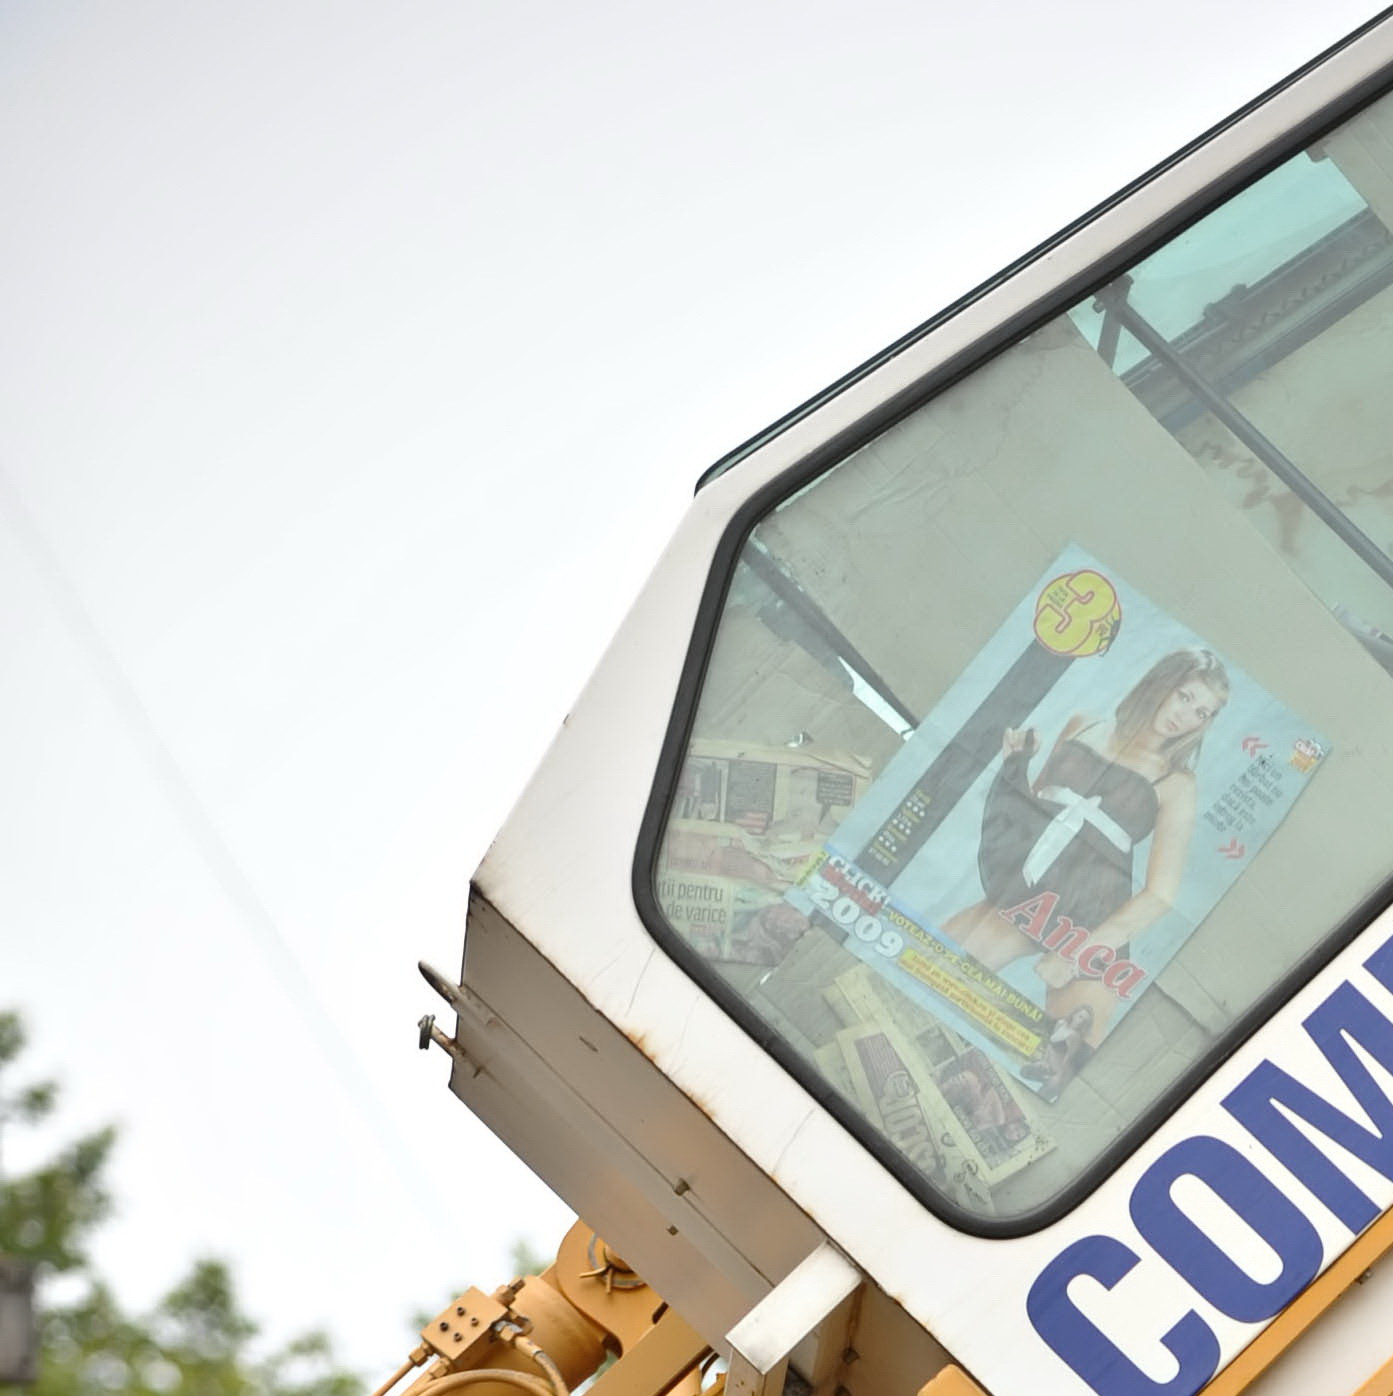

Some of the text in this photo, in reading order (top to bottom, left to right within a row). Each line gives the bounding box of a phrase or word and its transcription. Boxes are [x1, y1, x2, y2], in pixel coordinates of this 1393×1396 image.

[1034, 570, 1116, 654] 3
[678, 881, 724, 903] pentru
[803, 874, 904, 958] 2009
[999, 890, 1147, 999] Anca
